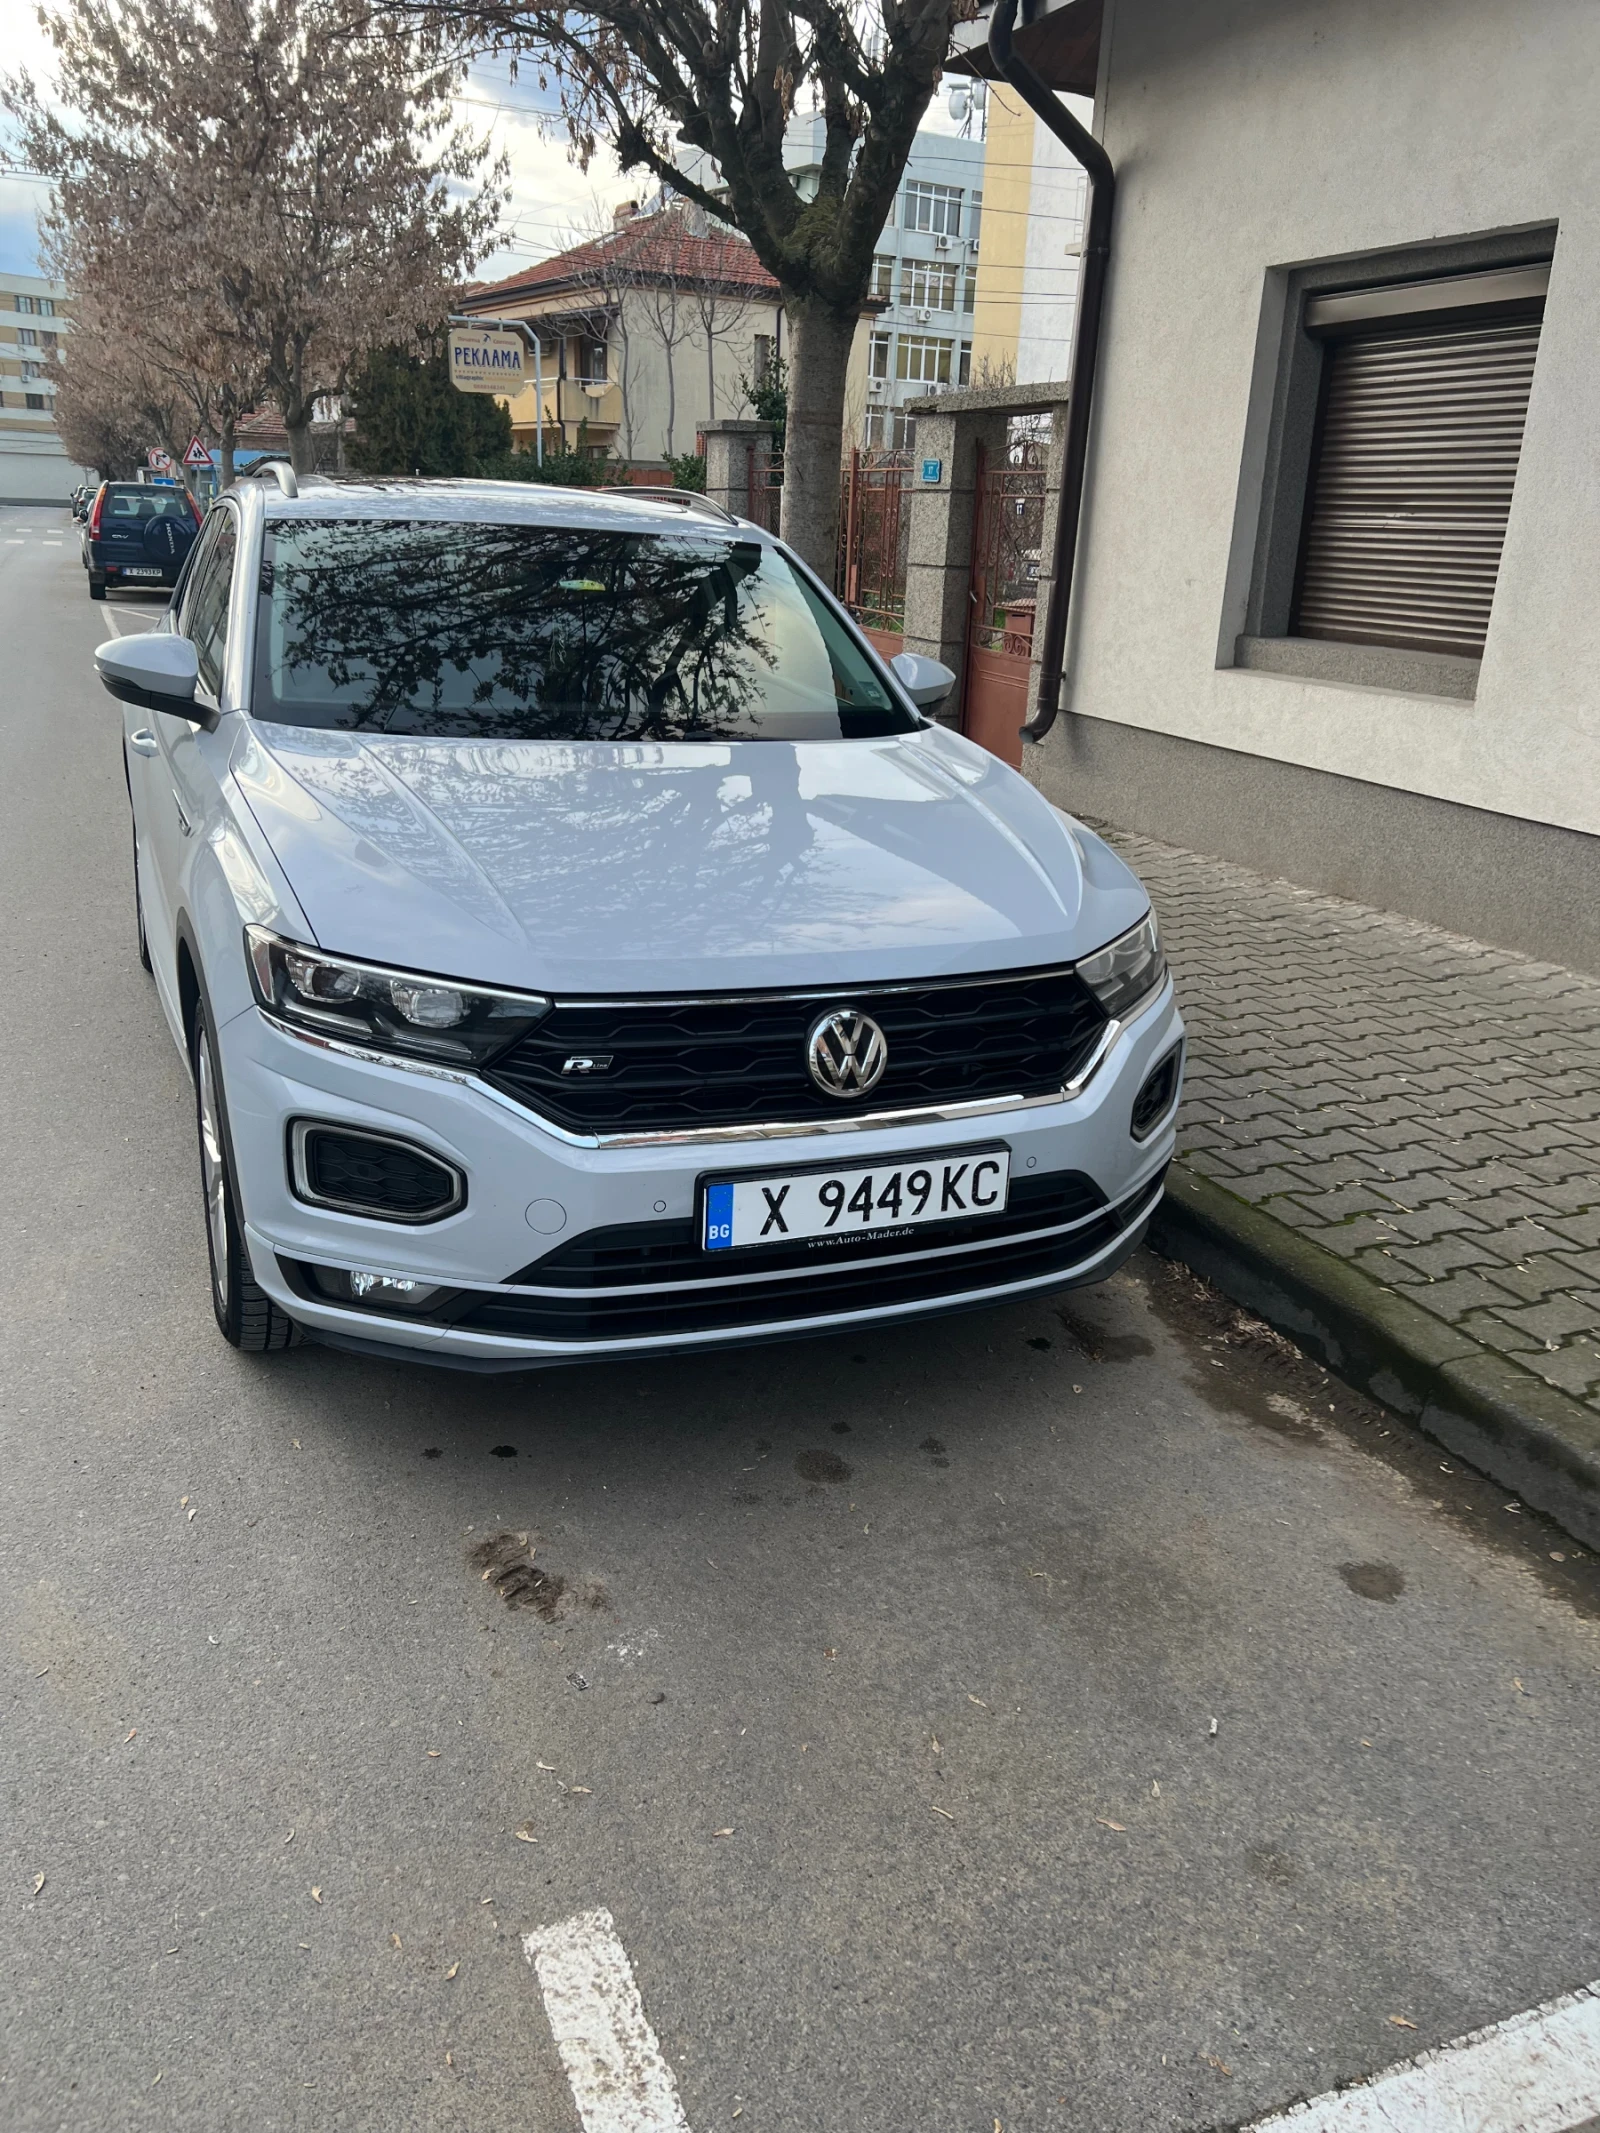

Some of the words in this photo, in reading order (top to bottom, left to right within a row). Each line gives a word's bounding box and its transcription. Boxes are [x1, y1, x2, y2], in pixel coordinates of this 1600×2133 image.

[454, 346, 522, 370] РЕКЛАМА
[760, 1185, 790, 1236] X
[709, 1223, 730, 1240] BG
[807, 1227, 915, 1249] www.Auto-Mader.de
